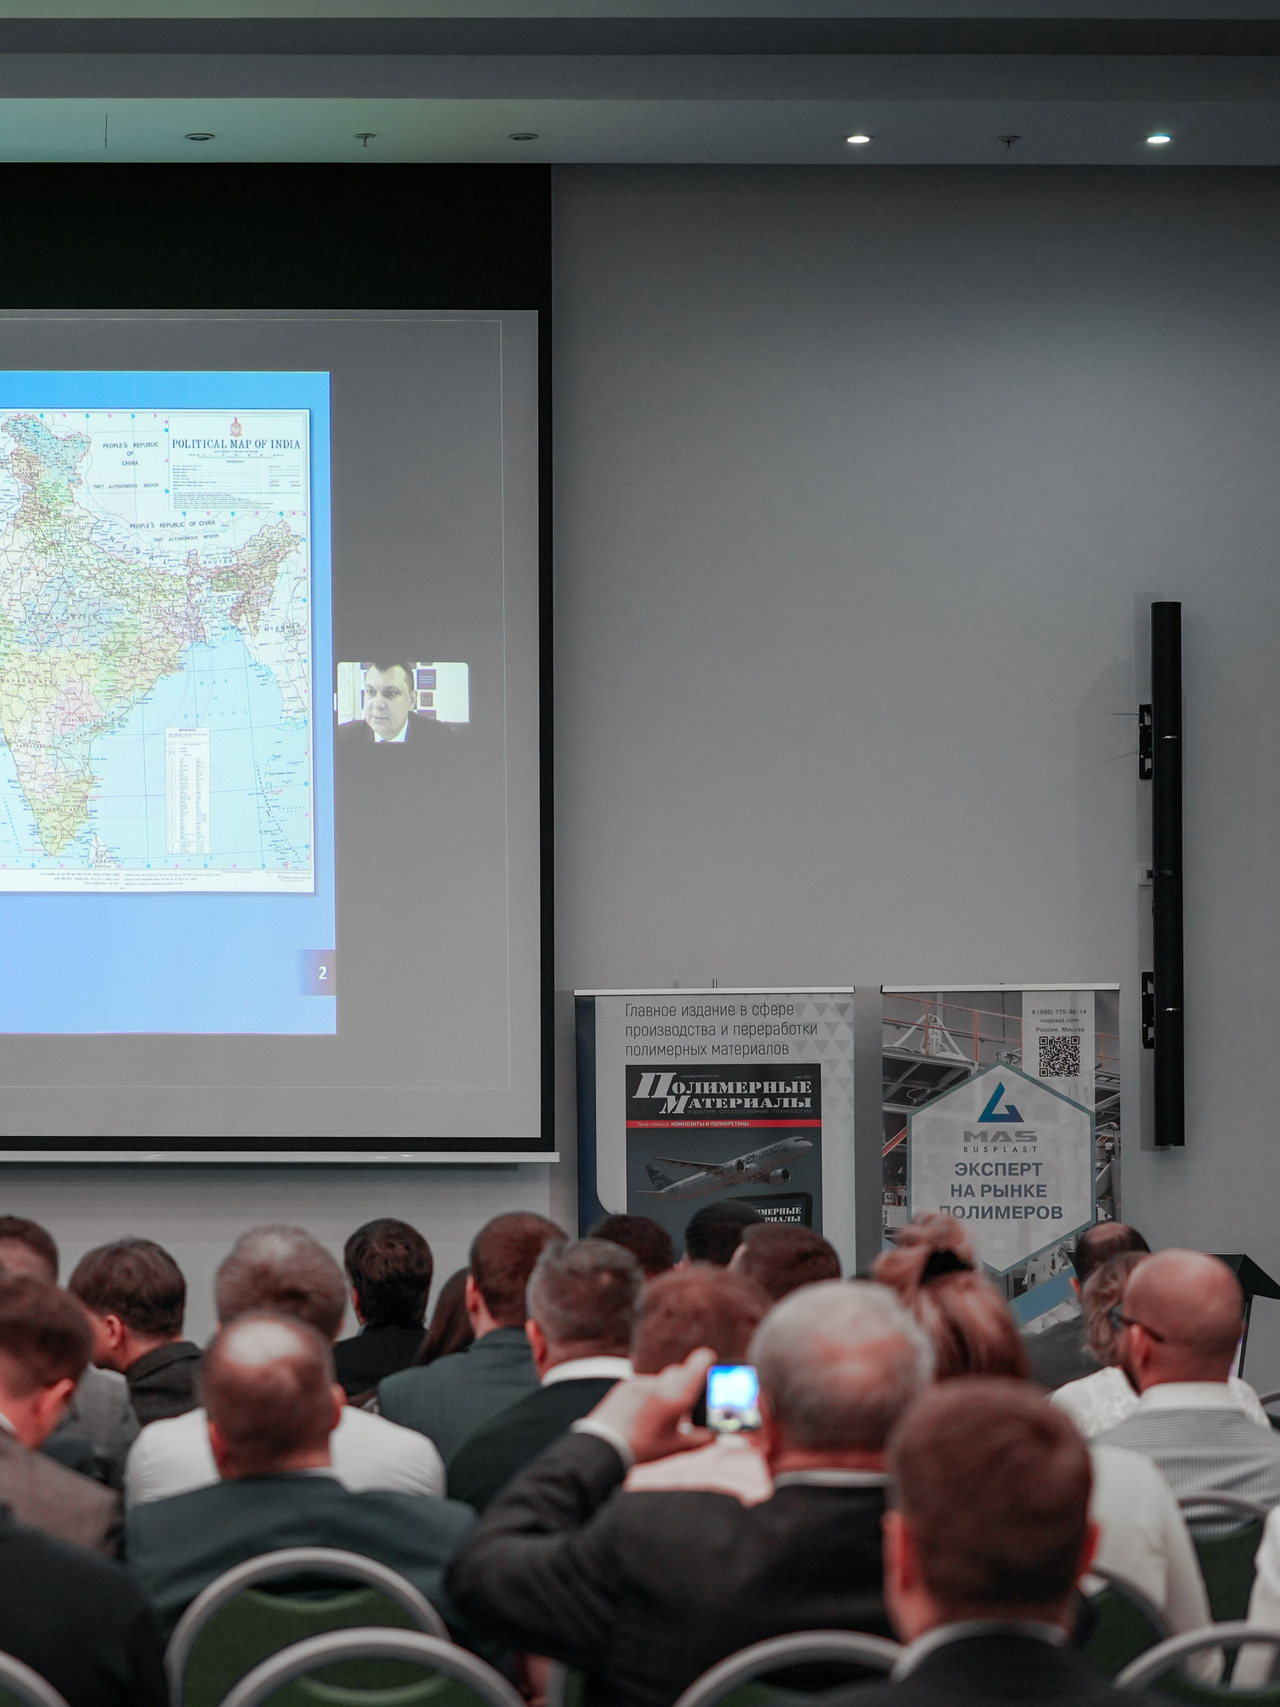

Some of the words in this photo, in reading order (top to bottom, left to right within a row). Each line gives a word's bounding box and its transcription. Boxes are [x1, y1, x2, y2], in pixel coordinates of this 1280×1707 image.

[172, 439, 228, 450] POLITICAL
[230, 439, 252, 449] MAP
[255, 439, 268, 449] OF
[271, 439, 301, 449] INDIA
[318, 965, 328, 980] 2
[625, 1003, 677, 1018] Главное
[681, 1004, 736, 1018] издание
[740, 1005, 748, 1016] в
[751, 1002, 794, 1019] сфере
[625, 1024, 716, 1039] производства
[720, 1025, 729, 1036] и
[733, 1021, 818, 1039] переработки
[625, 1044, 707, 1059] полимерных
[711, 1043, 790, 1059] материалов
[632, 1072, 812, 1098] ПОЛИМЕРНЫЕ
[659, 1095, 812, 1114] МАТЕРИАЛЫ
[963, 1130, 1038, 1143] MAS
[963, 1145, 1037, 1153] RUSPLAST
[954, 1162, 1043, 1177] ЭКСПЕРТ
[950, 1184, 976, 1198] НА
[980, 1184, 1048, 1198] РЫНКЕ
[939, 1205, 1063, 1220] ПОЛИМЕРОВ
